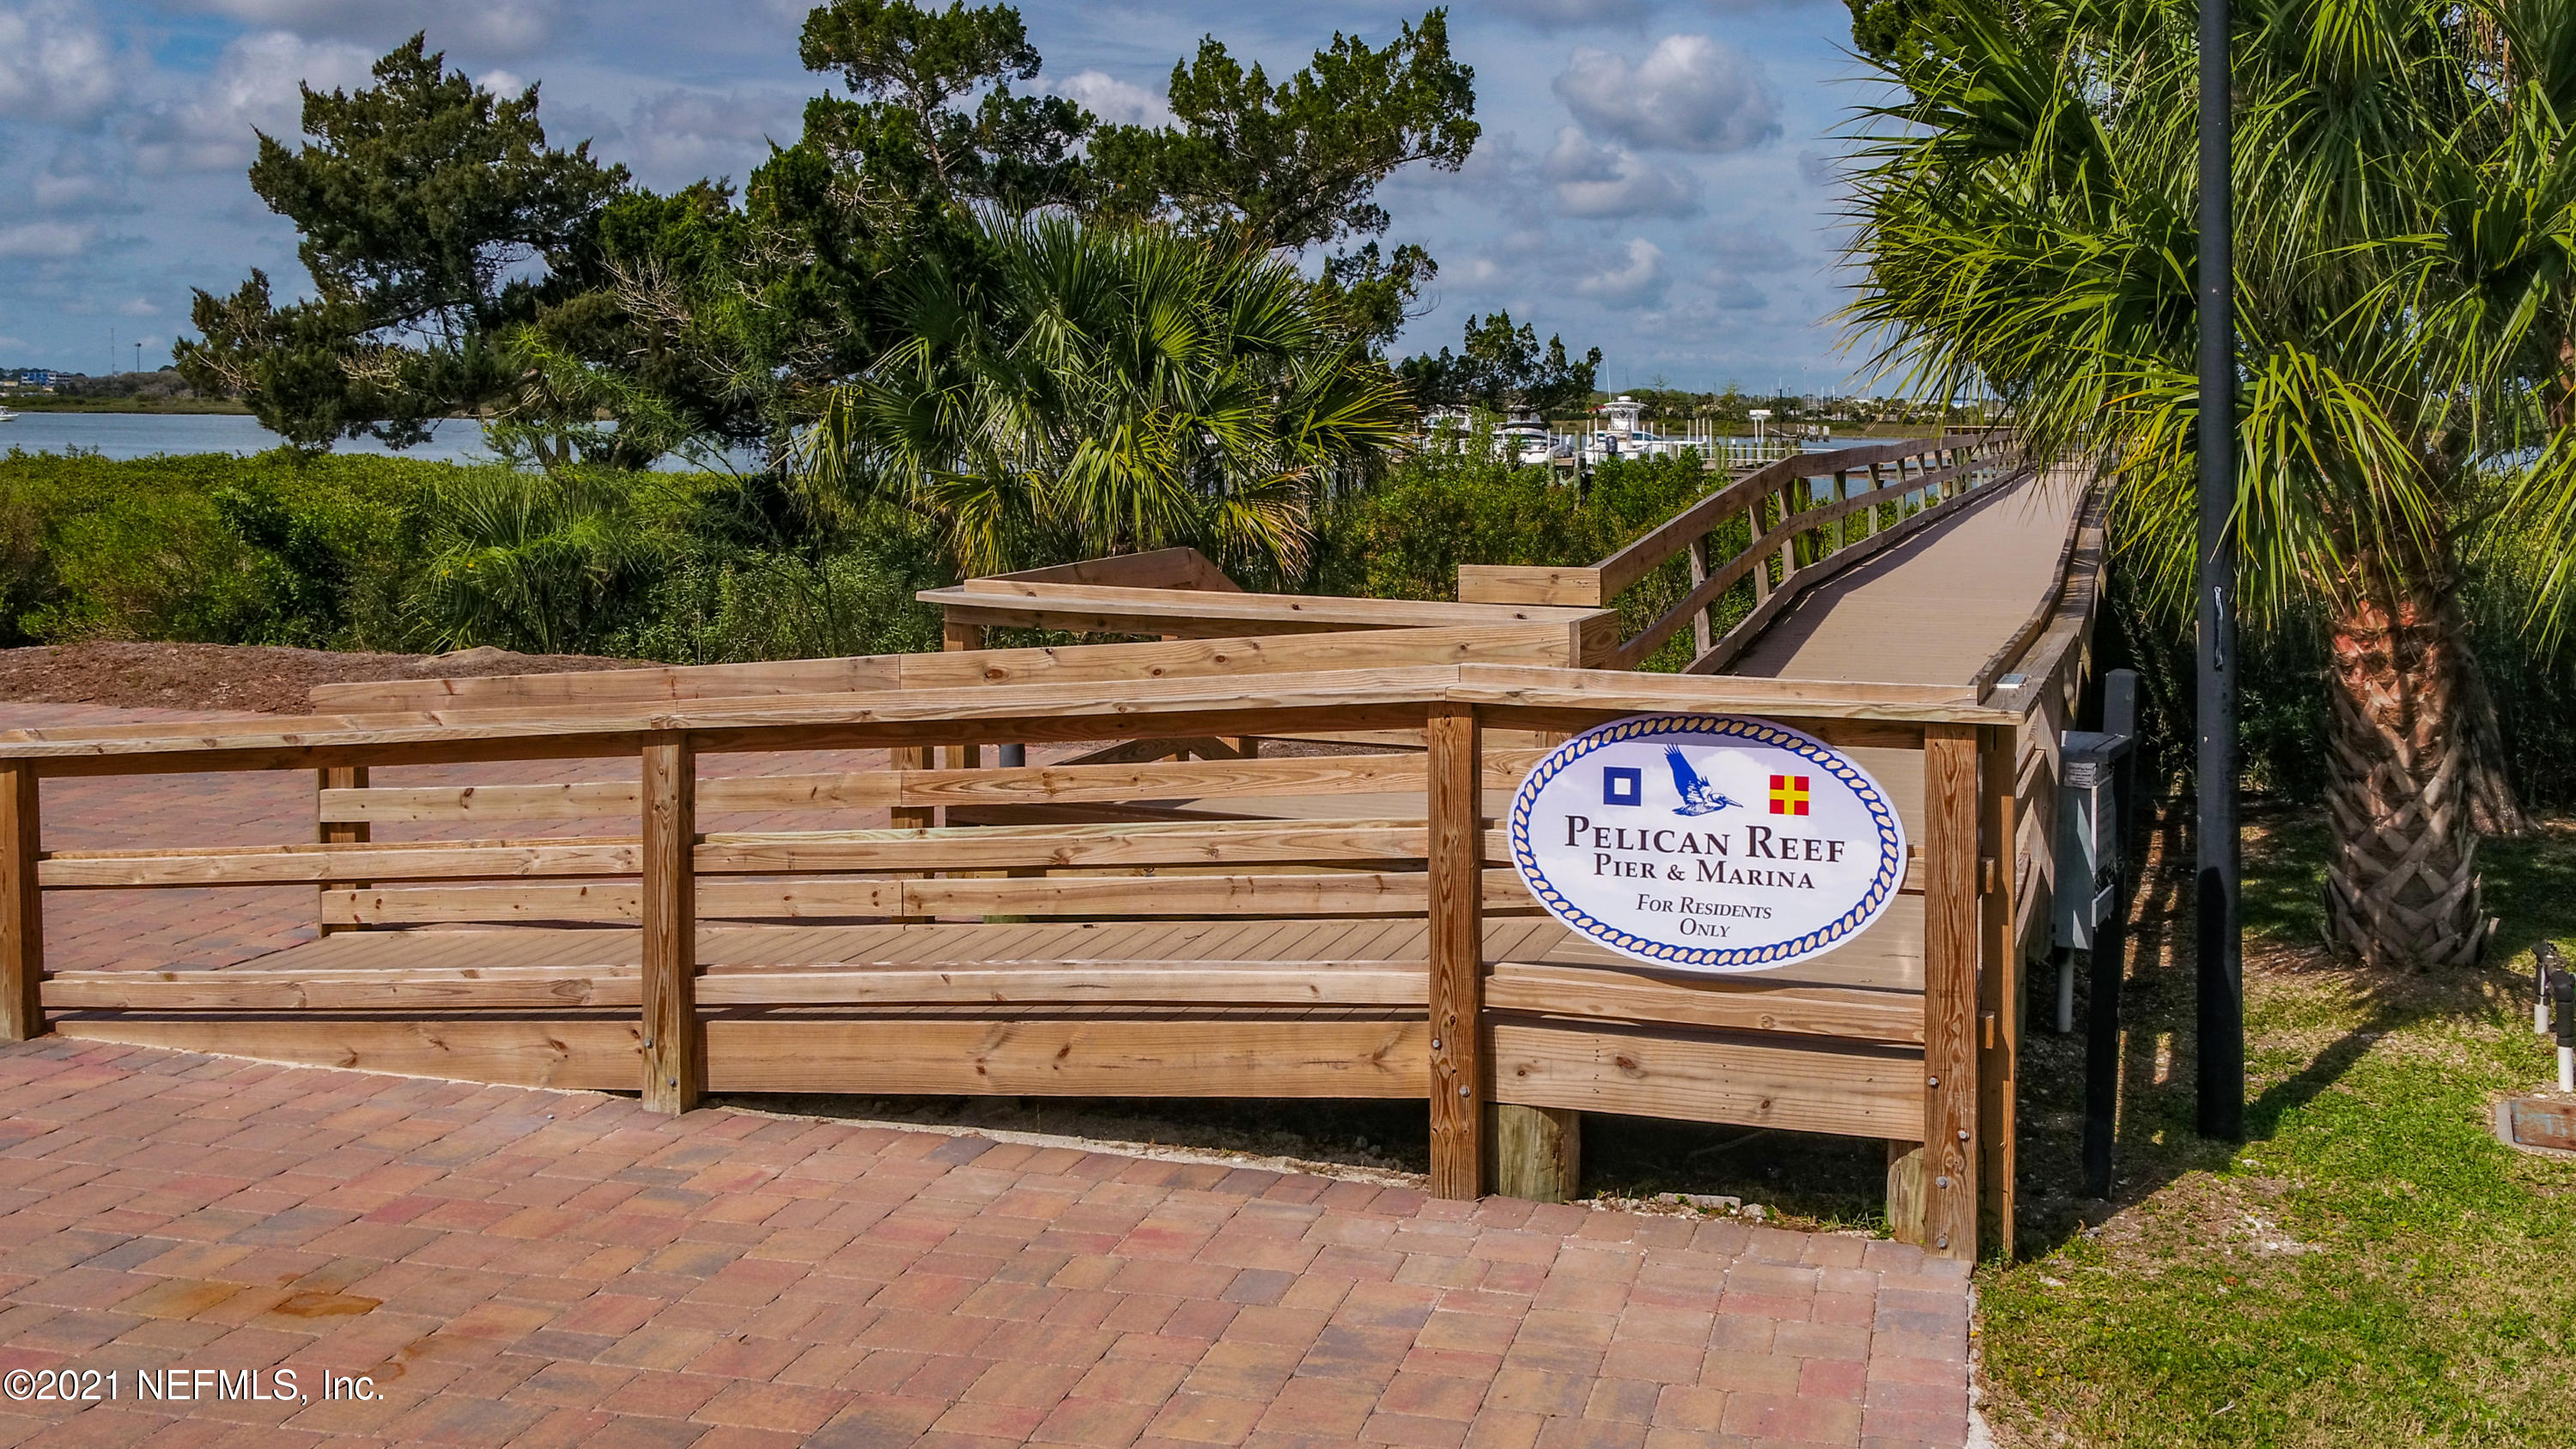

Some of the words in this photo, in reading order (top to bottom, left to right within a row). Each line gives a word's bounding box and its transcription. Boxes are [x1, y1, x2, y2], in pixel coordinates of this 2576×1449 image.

[1564, 814, 1731, 856] PELICAN
[1745, 825, 1845, 863] REEF
[1593, 852, 1657, 880] PIER
[1667, 863, 1686, 881] &
[1696, 858, 1815, 890] MARINA
[1636, 893, 1674, 913] FOR
[1679, 896, 1772, 920] RESIDENTS
[1680, 917, 1731, 938] ONLY
